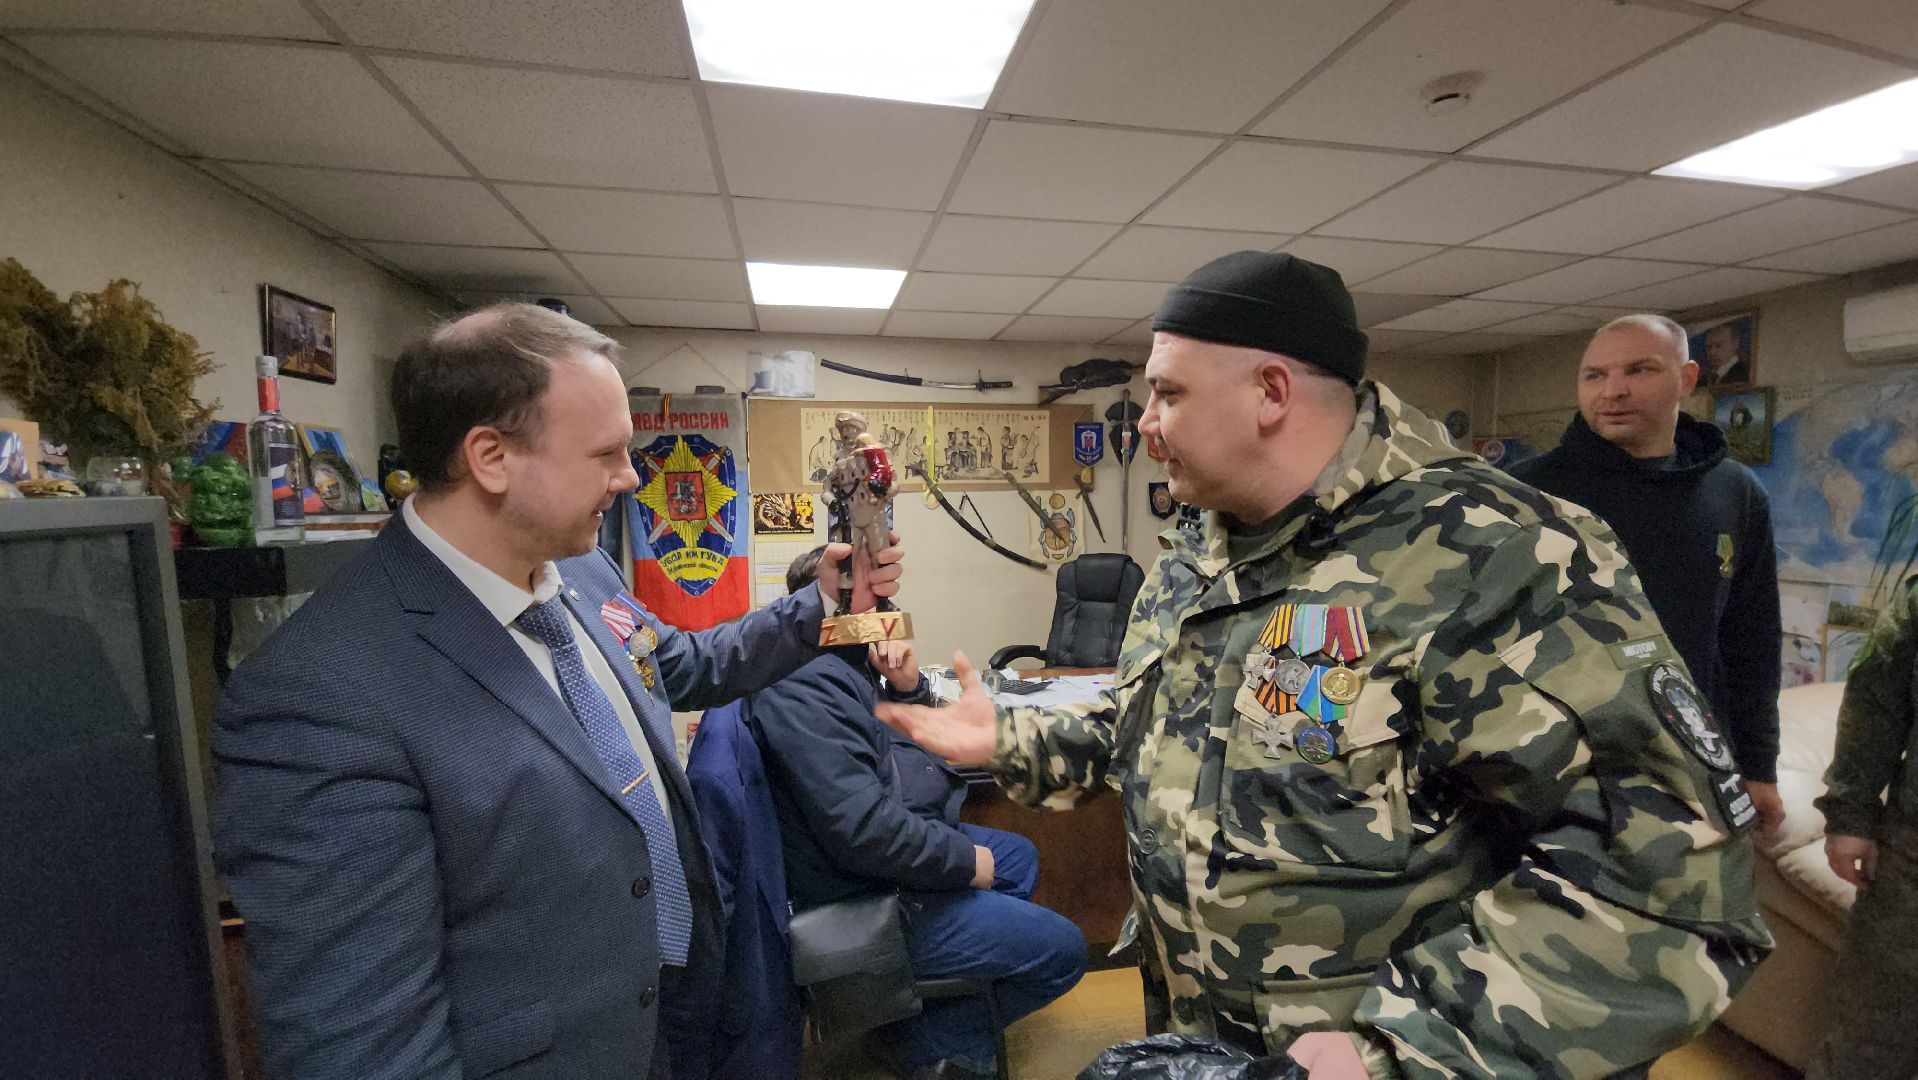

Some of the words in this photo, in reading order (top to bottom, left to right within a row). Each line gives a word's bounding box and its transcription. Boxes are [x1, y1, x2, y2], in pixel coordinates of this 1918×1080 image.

[668, 412, 729, 431] РОССИИ
[701, 550, 724, 566] ГУВД
[820, 624, 839, 645] Z
[880, 617, 900, 640] V
